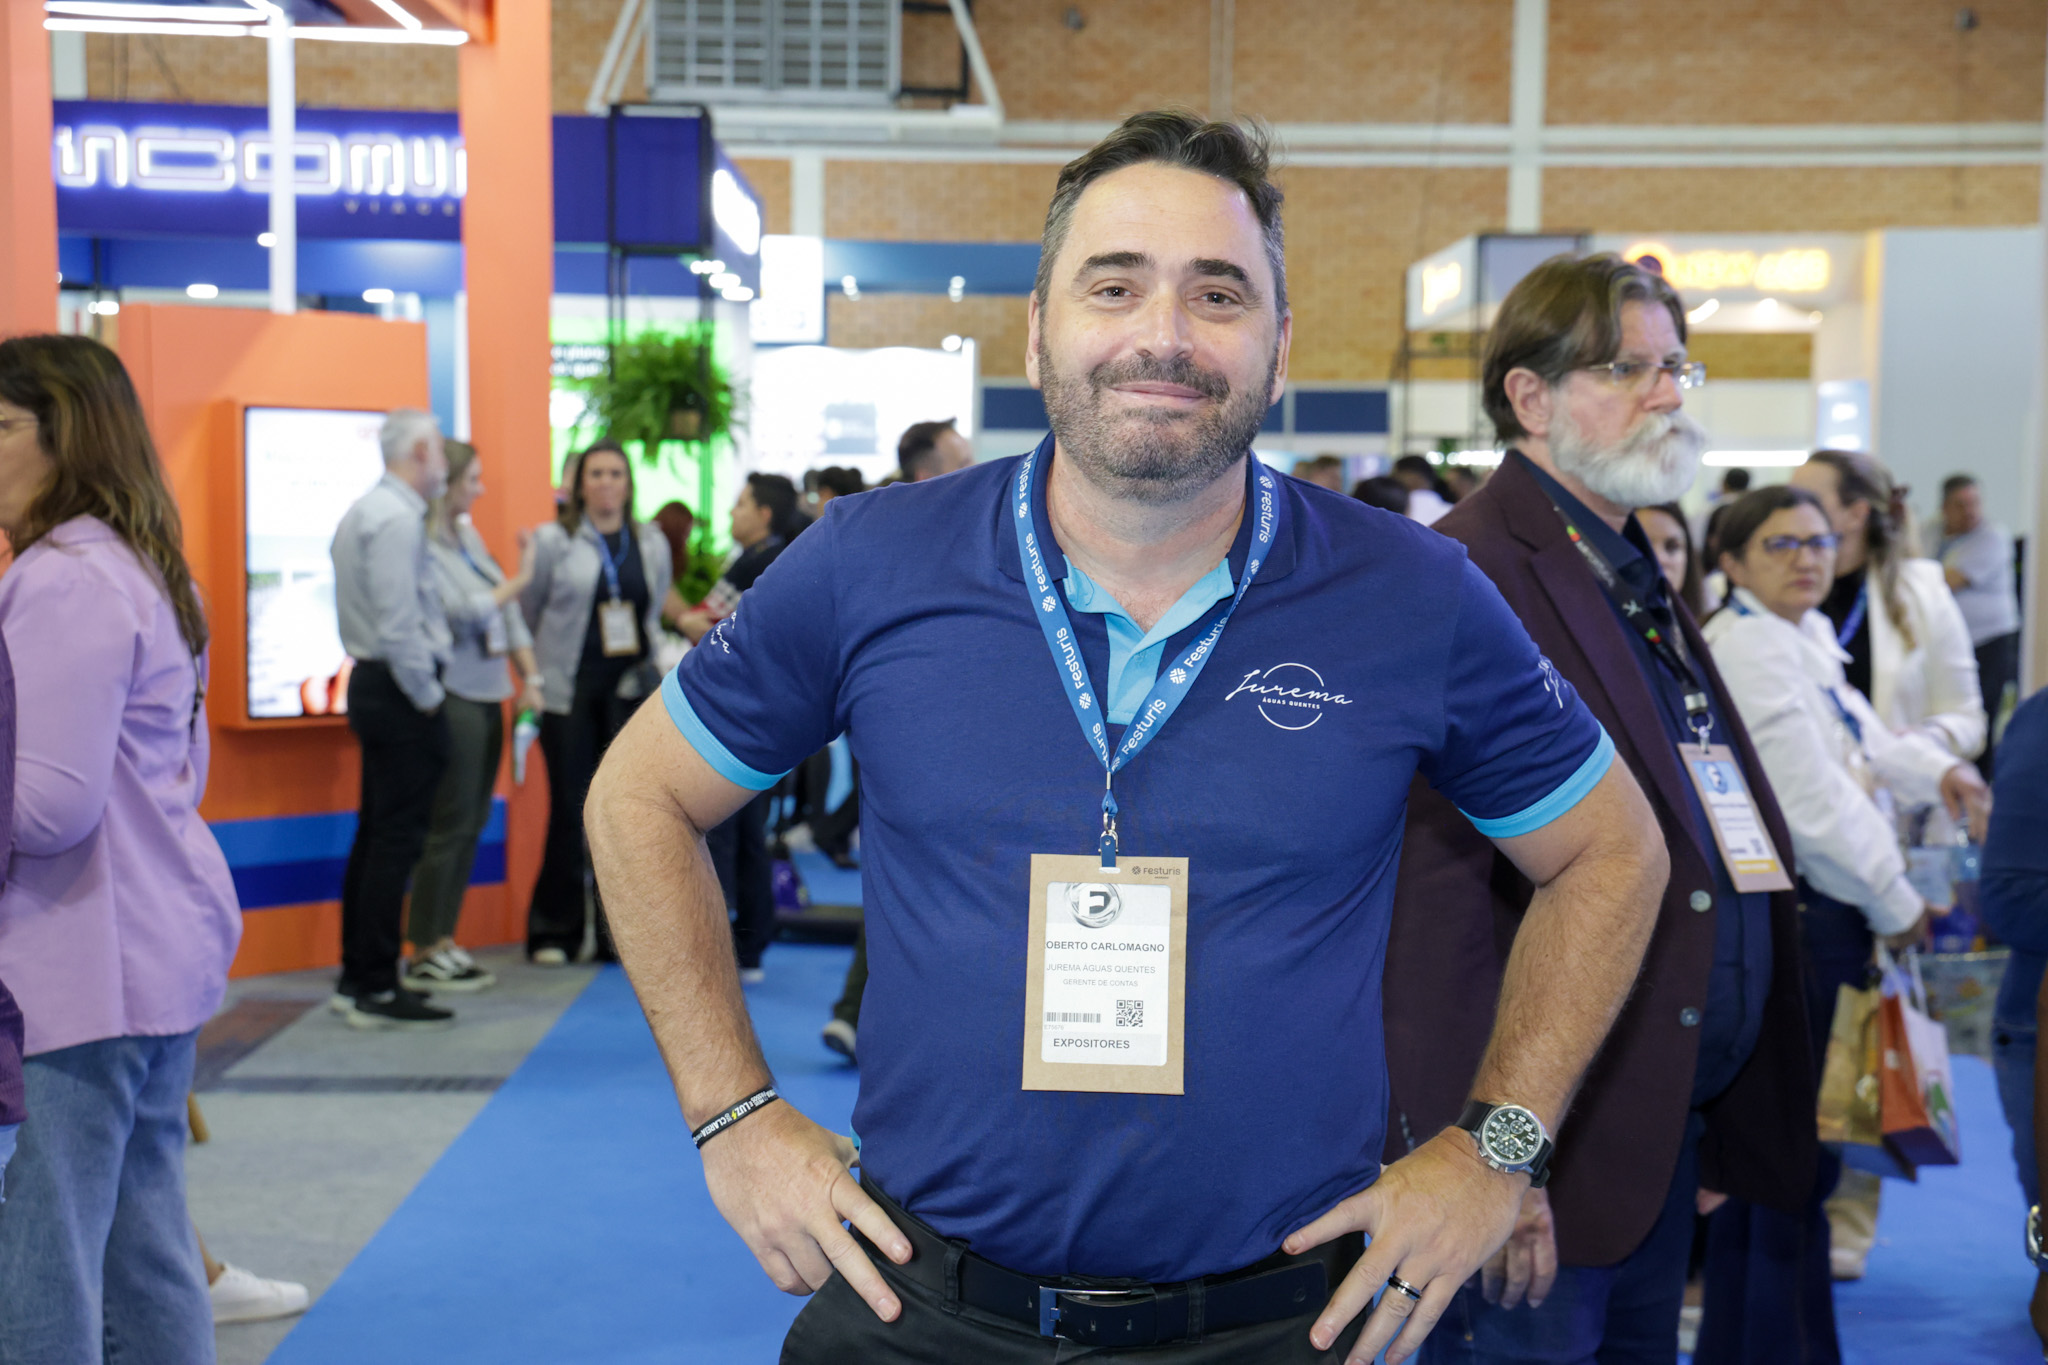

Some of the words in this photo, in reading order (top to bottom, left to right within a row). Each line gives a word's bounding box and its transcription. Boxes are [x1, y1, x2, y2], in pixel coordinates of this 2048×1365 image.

[1258, 490, 1274, 544] Festuris
[1025, 532, 1049, 593] Festuris
[1183, 616, 1228, 668] Festuris
[1056, 627, 1085, 690] Festuris
[1225, 669, 1353, 704] Jurema
[1289, 700, 1320, 709] QUENTES
[1121, 699, 1167, 755] Festuris
[1143, 866, 1181, 875] Festuris
[1044, 941, 1088, 950] OBERTO
[1091, 942, 1165, 952] CARLOMAGNO
[1046, 963, 1081, 971] JUREMA
[1114, 965, 1156, 974] QUENTES
[1062, 978, 1096, 986] GERENTE
[1053, 1038, 1130, 1049] EXPOSITORES
[734, 1101, 752, 1117] LUZ
